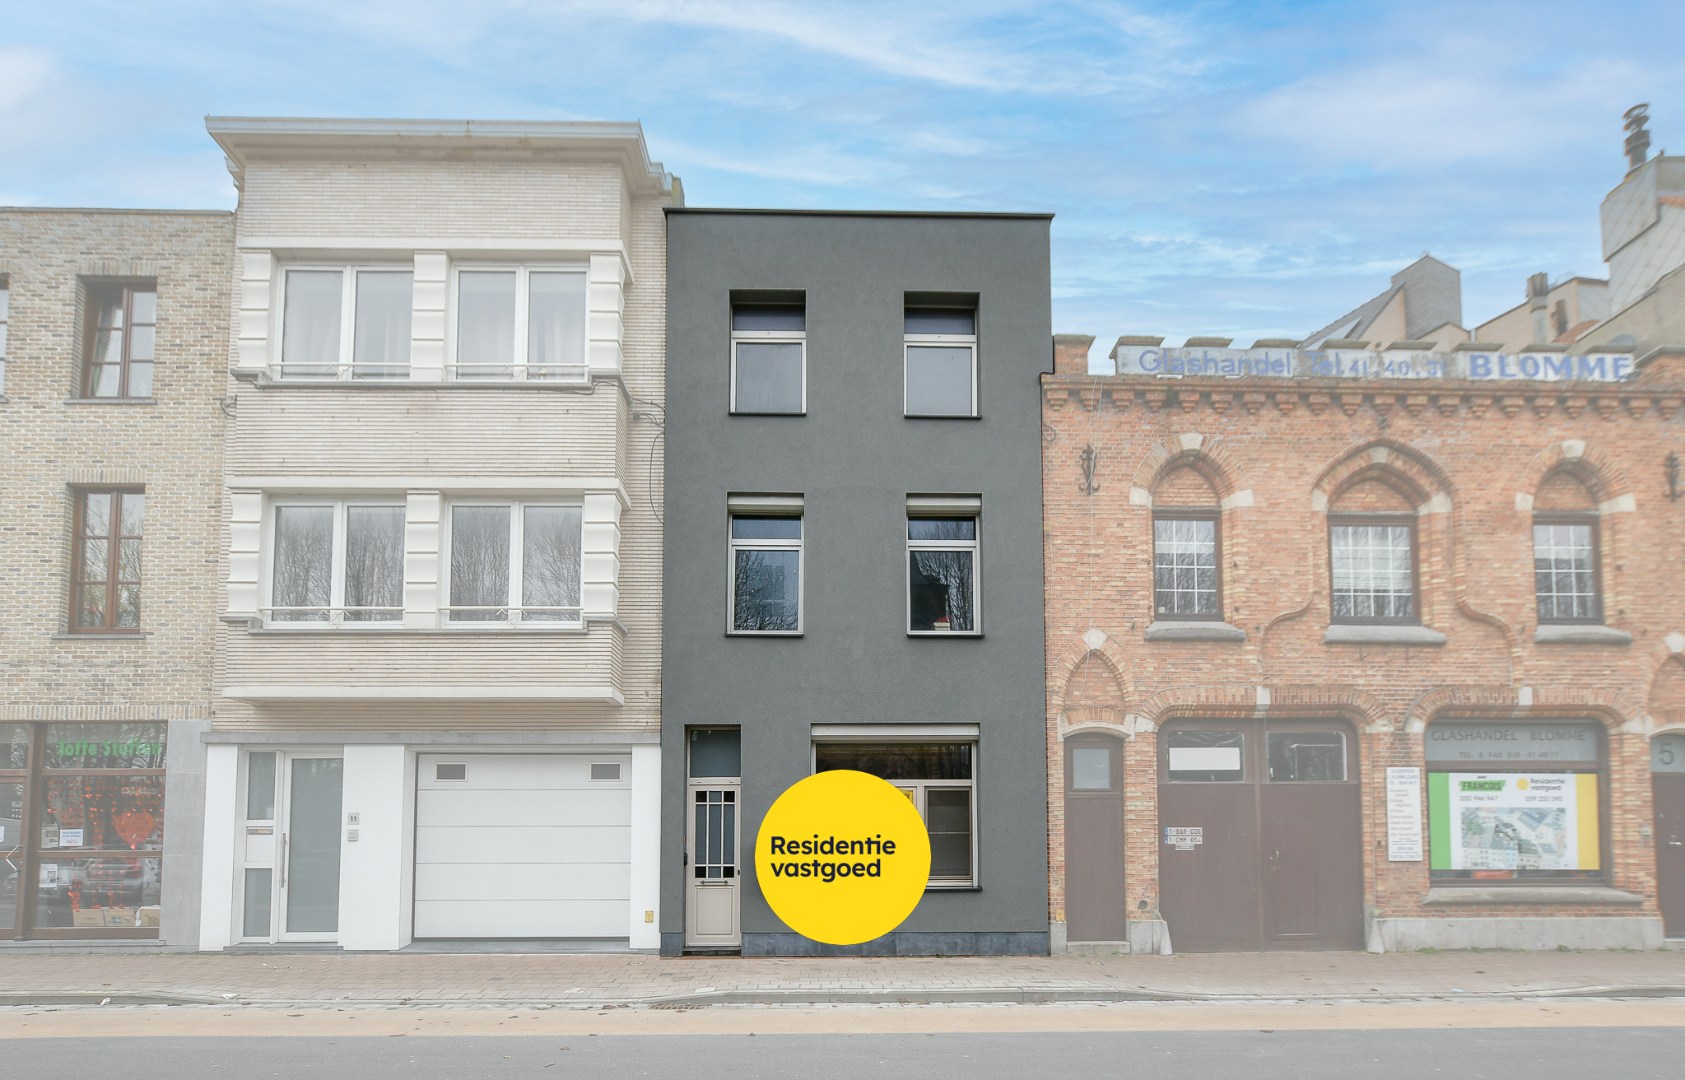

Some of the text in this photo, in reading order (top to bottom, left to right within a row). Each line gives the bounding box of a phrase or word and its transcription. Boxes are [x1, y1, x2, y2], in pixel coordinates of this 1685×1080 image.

[1139, 350, 1291, 375] Glashandel
[1470, 353, 1630, 380] BLOMME
[1431, 729, 1587, 741] GLASHANDEL BLOMME
[1659, 742, 1675, 765] 5
